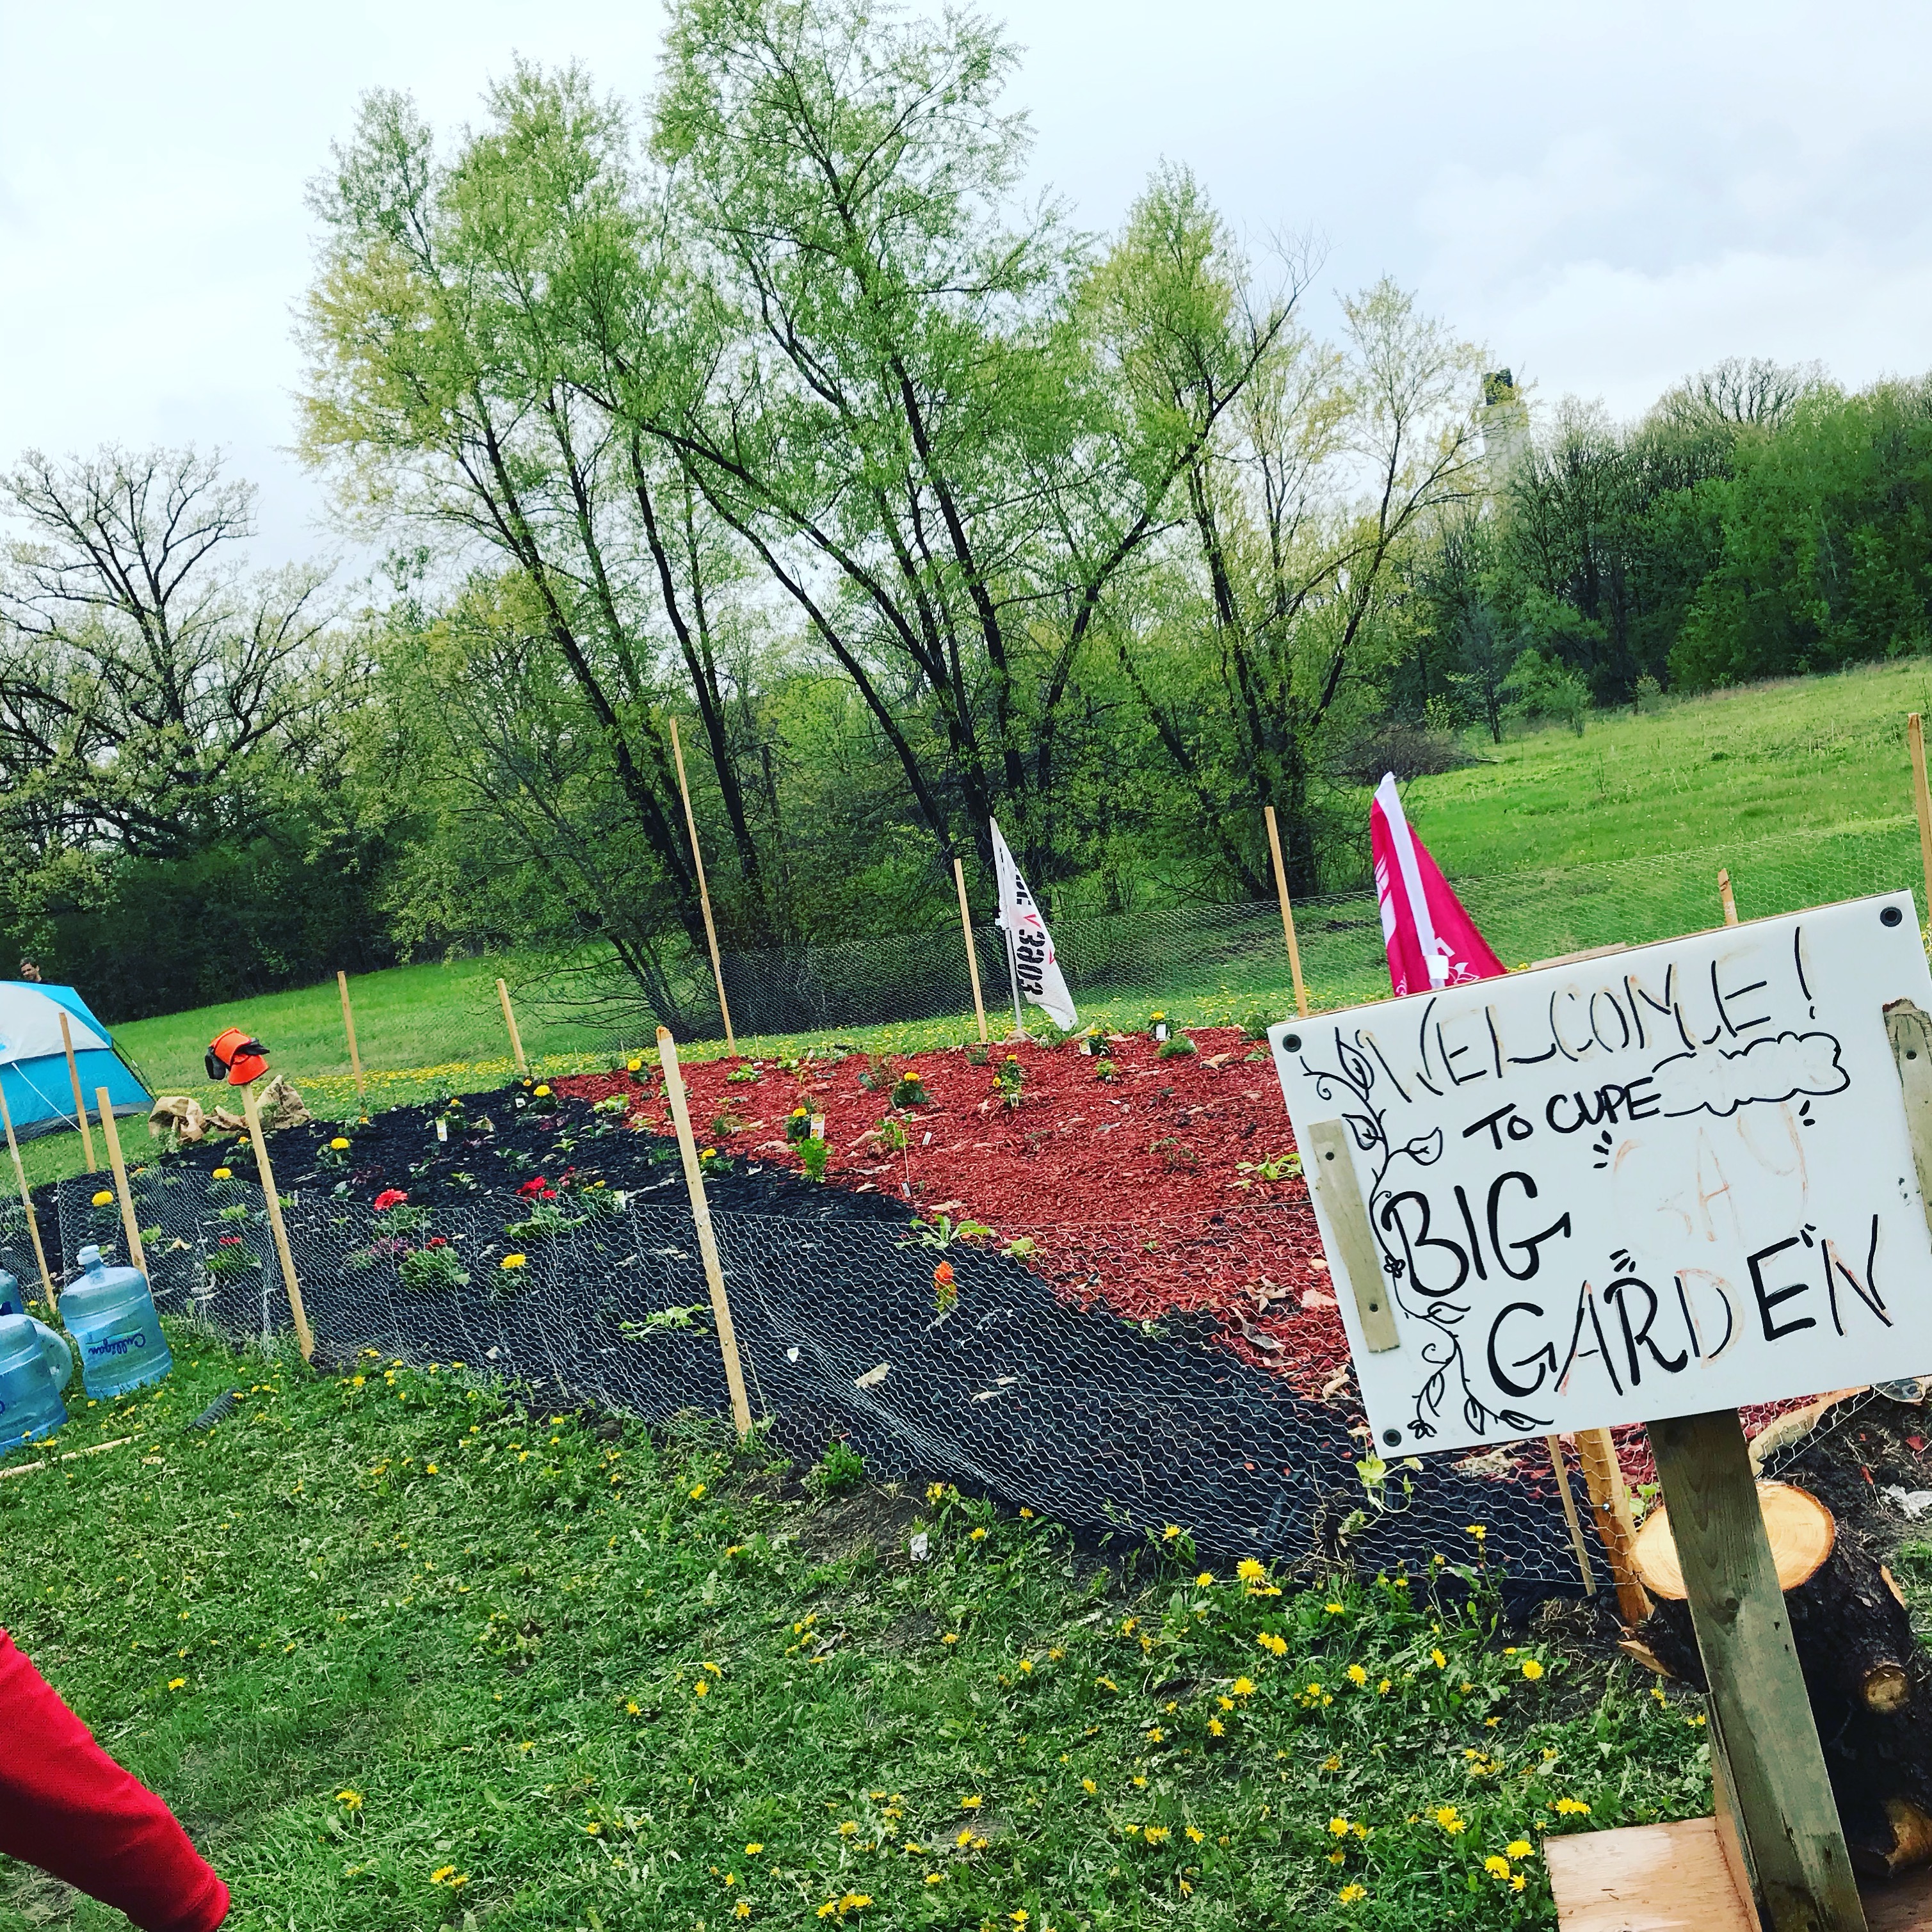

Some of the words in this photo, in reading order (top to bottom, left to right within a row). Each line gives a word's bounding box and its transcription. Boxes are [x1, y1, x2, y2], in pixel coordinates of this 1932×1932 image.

[1355, 926, 1817, 1103] WELCOME!
[1545, 1076, 1662, 1134] CUPE
[1381, 1171, 1571, 1297] BIG
[88, 1333, 146, 1355] Culligan
[1486, 1214, 1894, 1397] GARDEN
